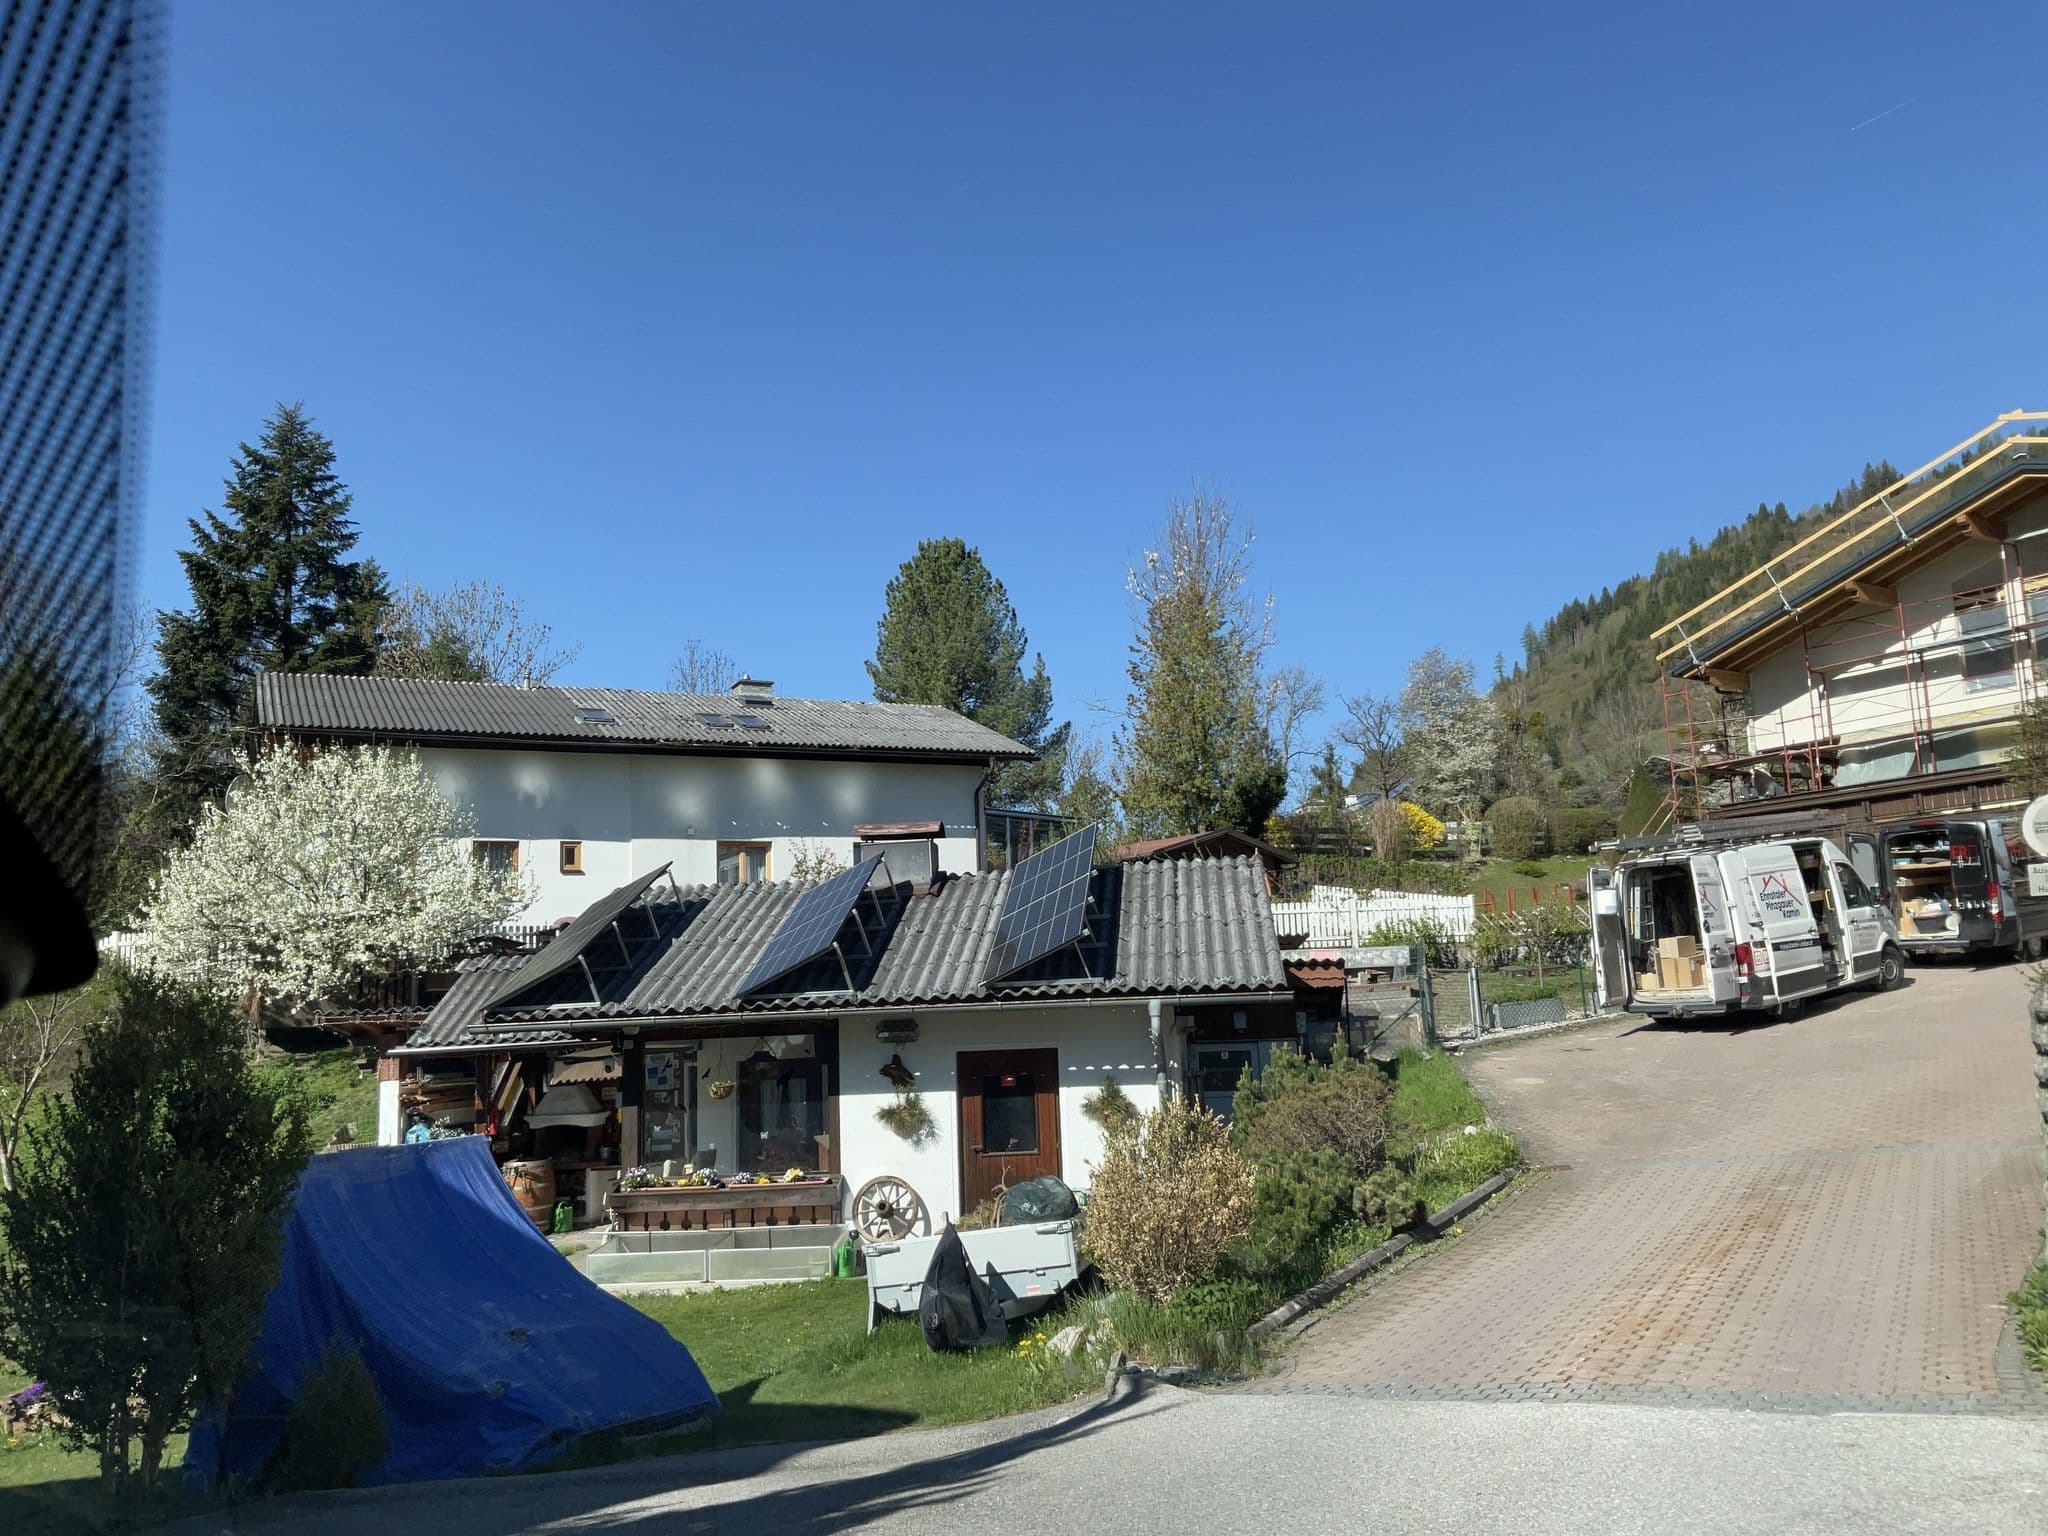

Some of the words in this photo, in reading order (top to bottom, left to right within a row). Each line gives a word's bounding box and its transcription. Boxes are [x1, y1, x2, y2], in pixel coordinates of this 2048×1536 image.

[1760, 890, 1786, 901] Ennstaler
[1765, 900, 1794, 911] Pinzgauer
[1783, 909, 1801, 918] Kamin
